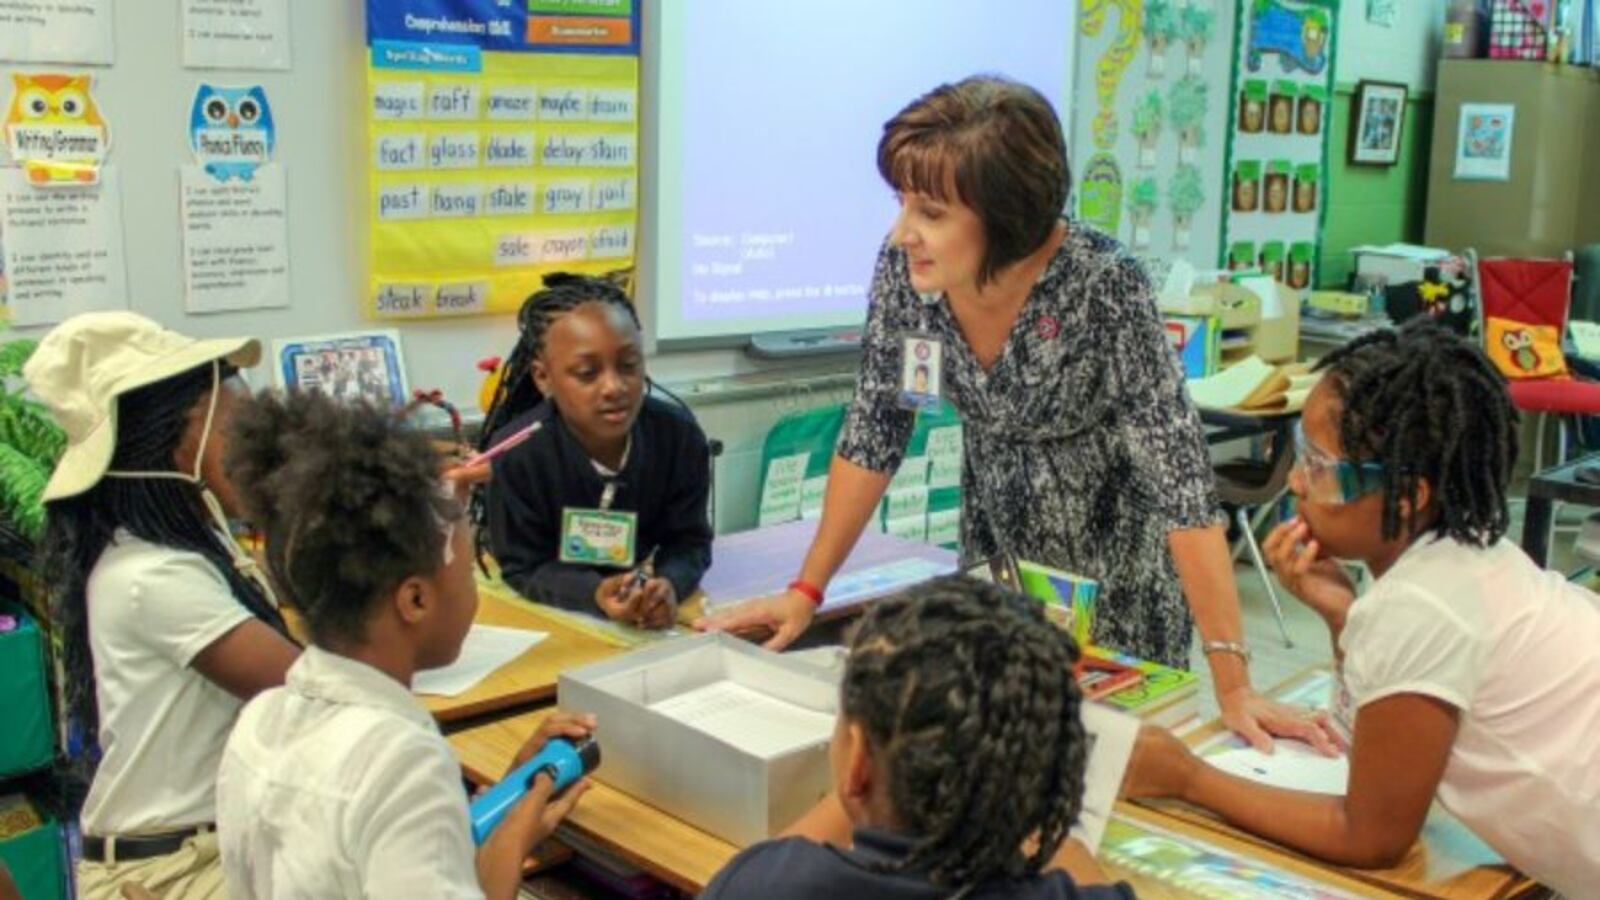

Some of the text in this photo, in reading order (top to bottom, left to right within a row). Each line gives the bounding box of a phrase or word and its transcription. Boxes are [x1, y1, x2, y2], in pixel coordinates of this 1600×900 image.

[375, 94, 418, 117] magic
[380, 139, 418, 164] fact
[431, 137, 477, 167] glass
[543, 137, 582, 163] delay
[380, 185, 419, 218] past
[545, 185, 583, 211] gray
[376, 285, 477, 311] steak break
